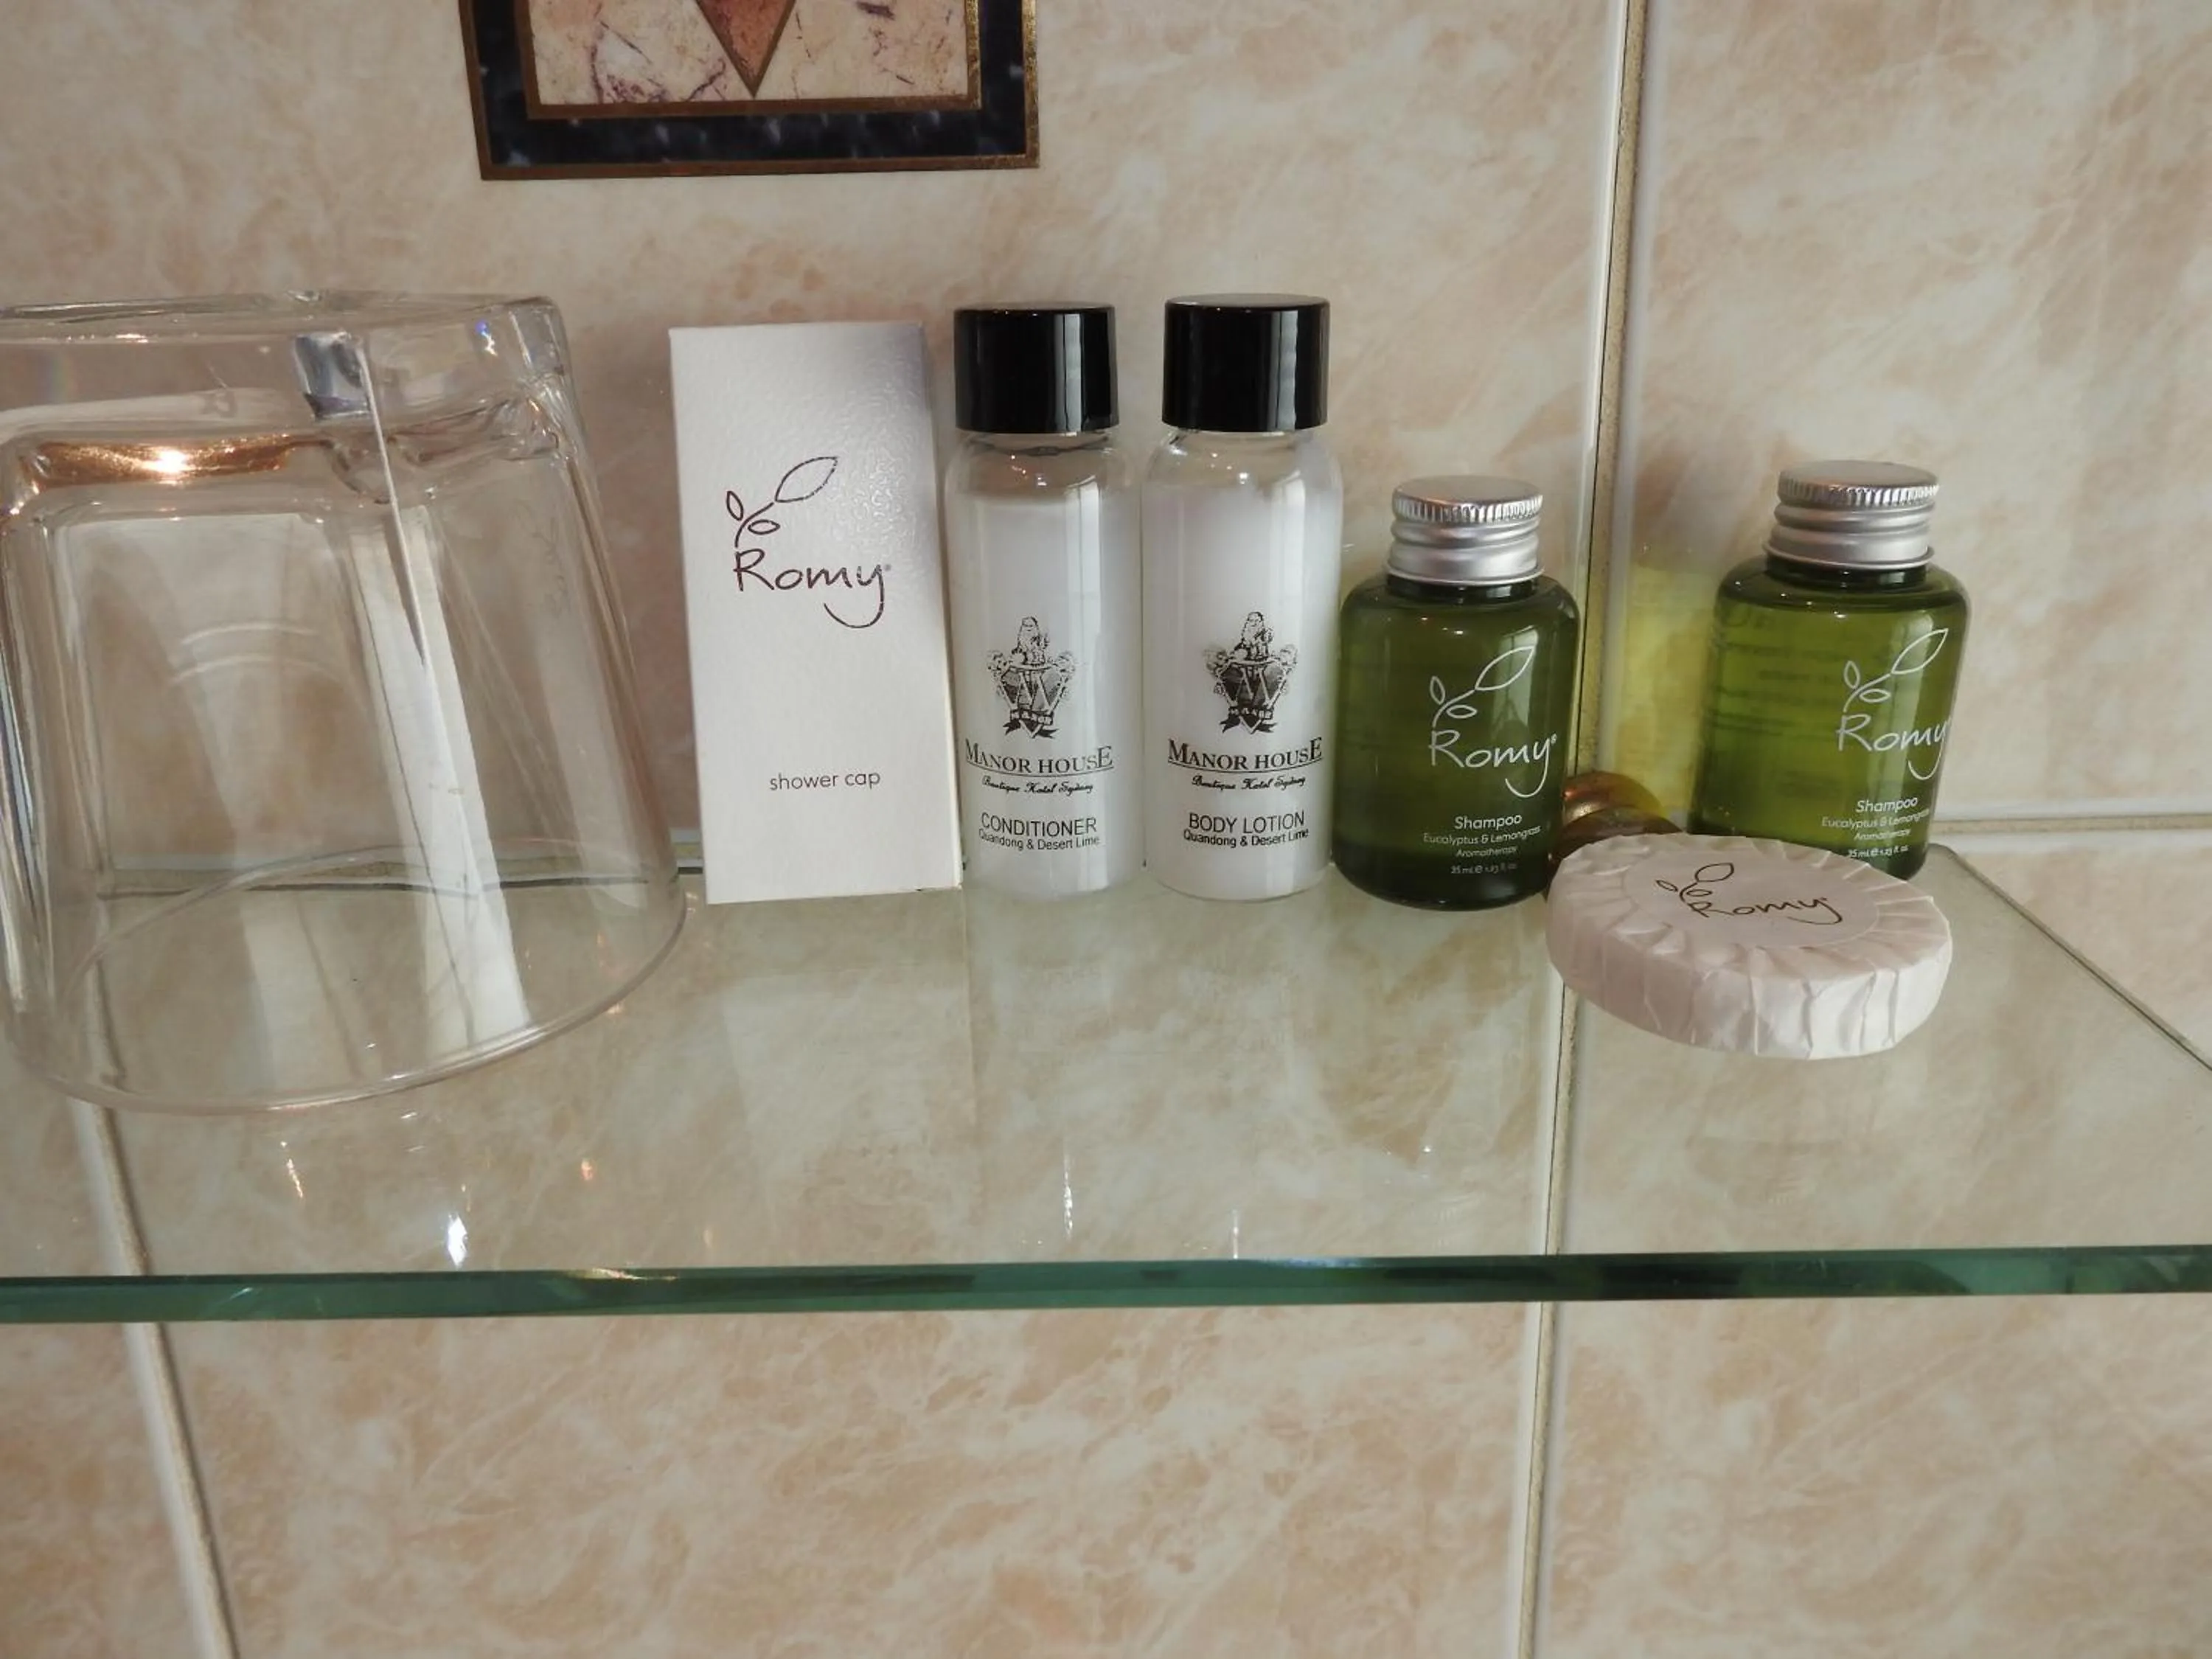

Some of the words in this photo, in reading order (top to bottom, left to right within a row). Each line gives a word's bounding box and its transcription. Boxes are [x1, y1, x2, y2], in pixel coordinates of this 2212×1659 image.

[965, 737, 1032, 773] MANOR
[1038, 745, 1113, 773] HOUSE
[1168, 738, 1248, 770] MANOR
[1255, 737, 1323, 769] HOUSE
[770, 773, 838, 792] shower
[845, 771, 881, 789] cap
[1856, 797, 1918, 813] Shampoo
[981, 812, 1097, 837] CONDITIONER
[1189, 812, 1237, 833] BODY
[1243, 810, 1304, 834] LOTION
[1454, 815, 1523, 830] Shampoo
[1822, 816, 1877, 830] Eucalyptus
[979, 828, 1024, 851] Quandong
[1027, 839, 1033, 849] &
[1037, 838, 1073, 849] Desert
[1076, 835, 1099, 848] Lime
[1183, 829, 1237, 848] Quandong
[1240, 837, 1248, 846] &
[1252, 833, 1286, 846] Desert
[1288, 828, 1309, 841] Lime
[1423, 832, 1478, 846] Eucalyptus
